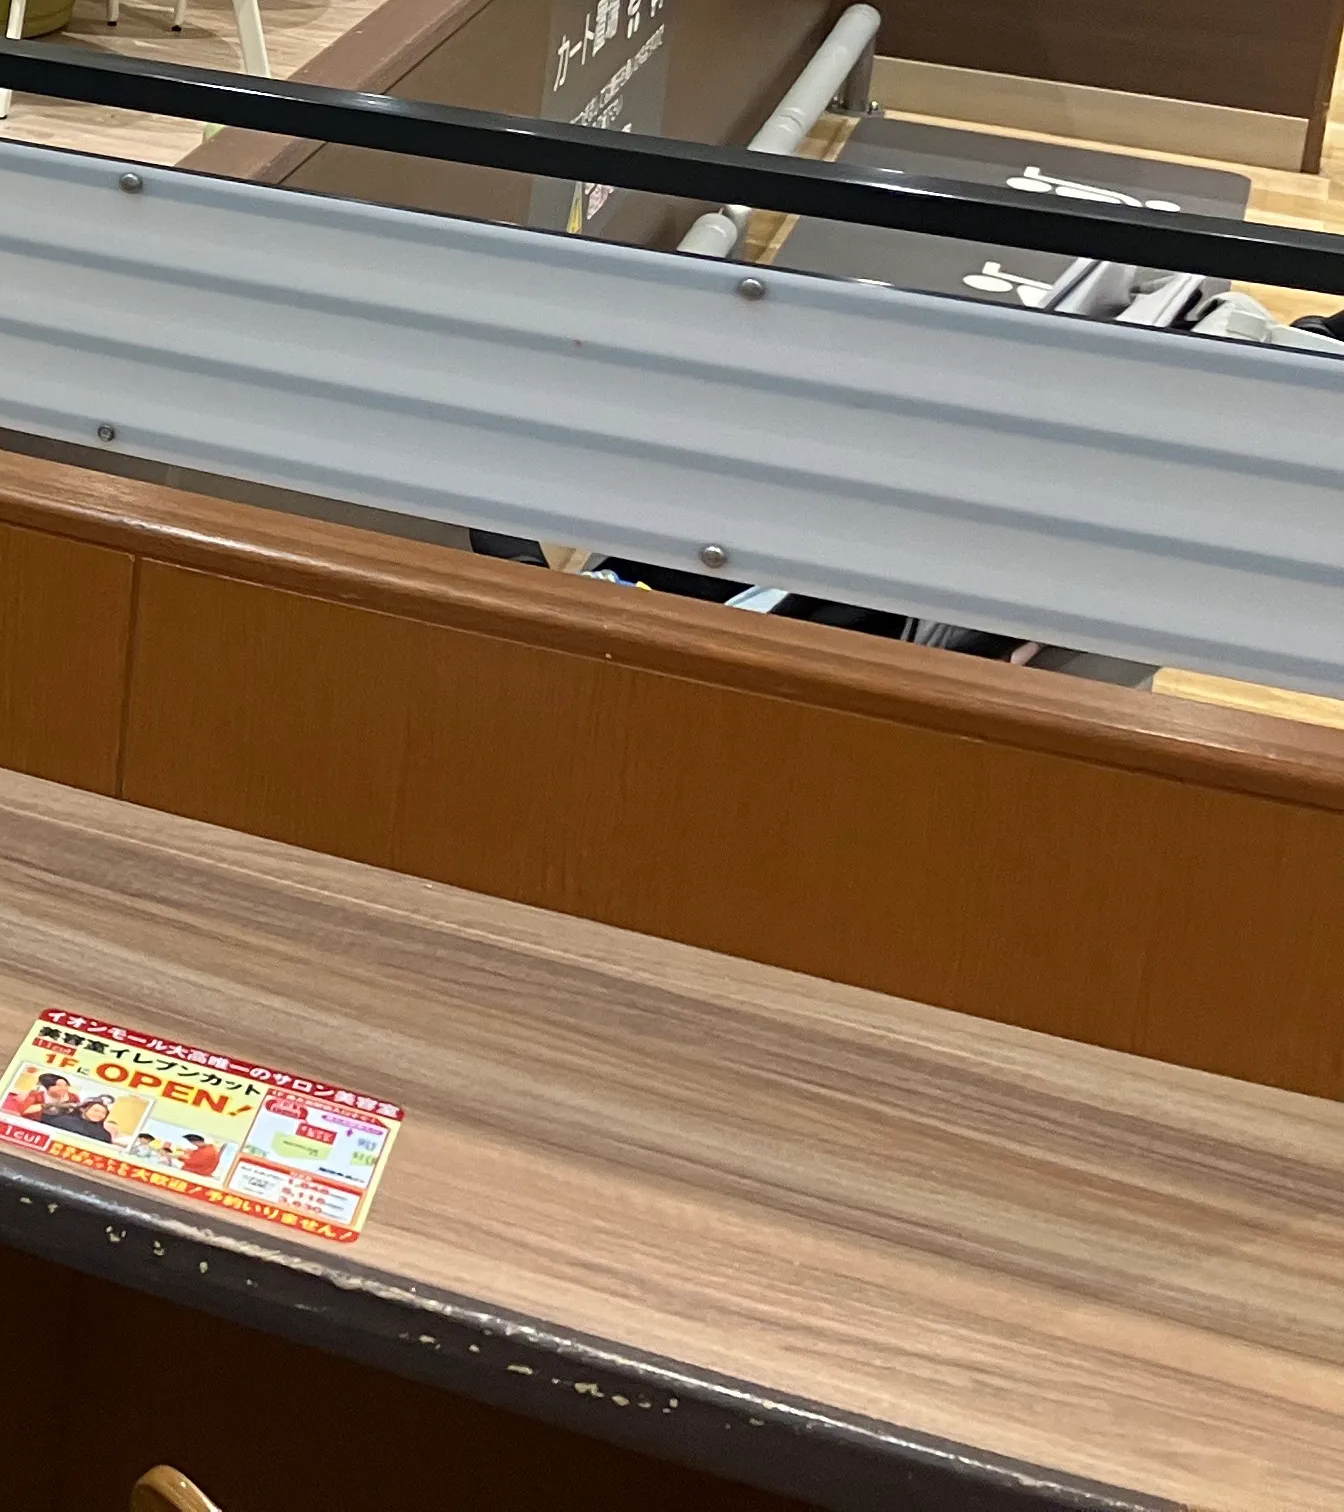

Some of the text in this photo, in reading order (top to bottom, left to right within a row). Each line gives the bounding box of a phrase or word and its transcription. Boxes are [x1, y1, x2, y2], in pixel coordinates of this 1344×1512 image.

[39, 1025, 262, 1097] 美容室イレブンカット
